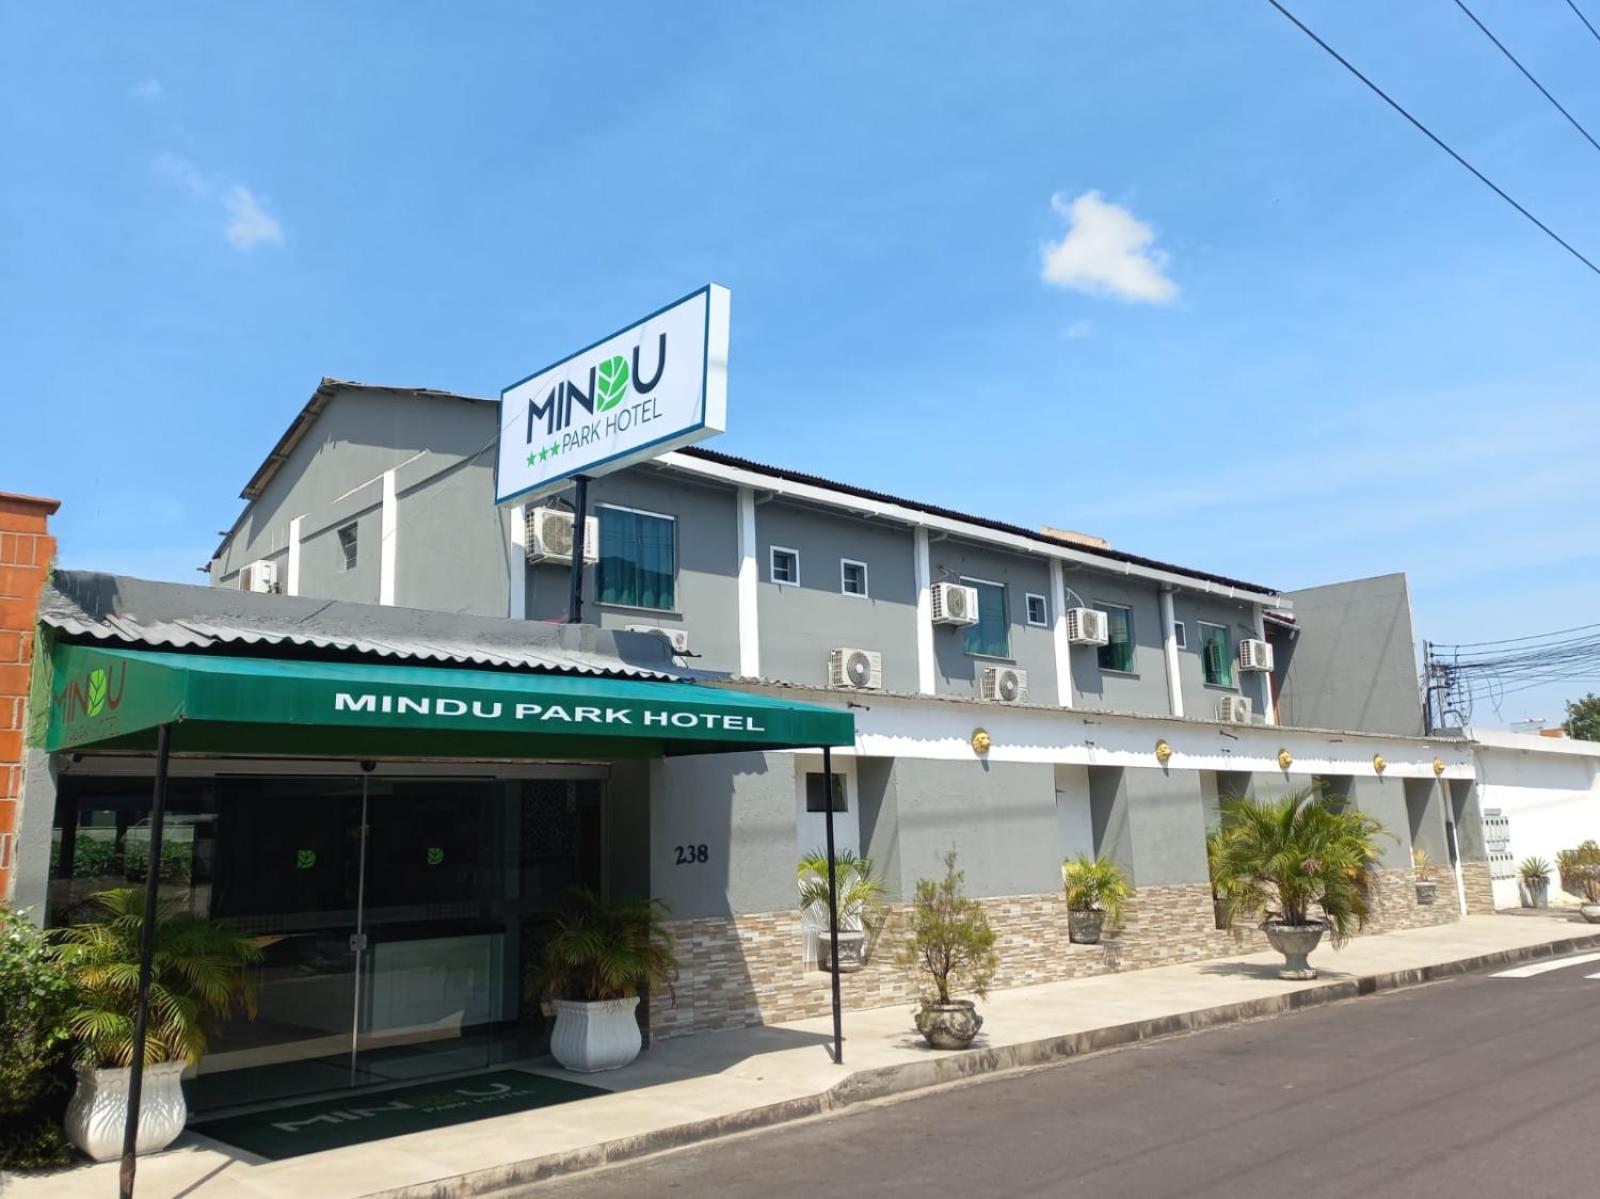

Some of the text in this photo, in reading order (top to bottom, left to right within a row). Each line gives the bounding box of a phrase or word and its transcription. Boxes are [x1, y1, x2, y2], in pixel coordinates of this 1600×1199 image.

[526, 332, 667, 445] MINDU
[562, 397, 663, 454] PARK HOTEL
[334, 692, 765, 732] MINDU PARK HOTEL
[673, 843, 709, 866] 238
